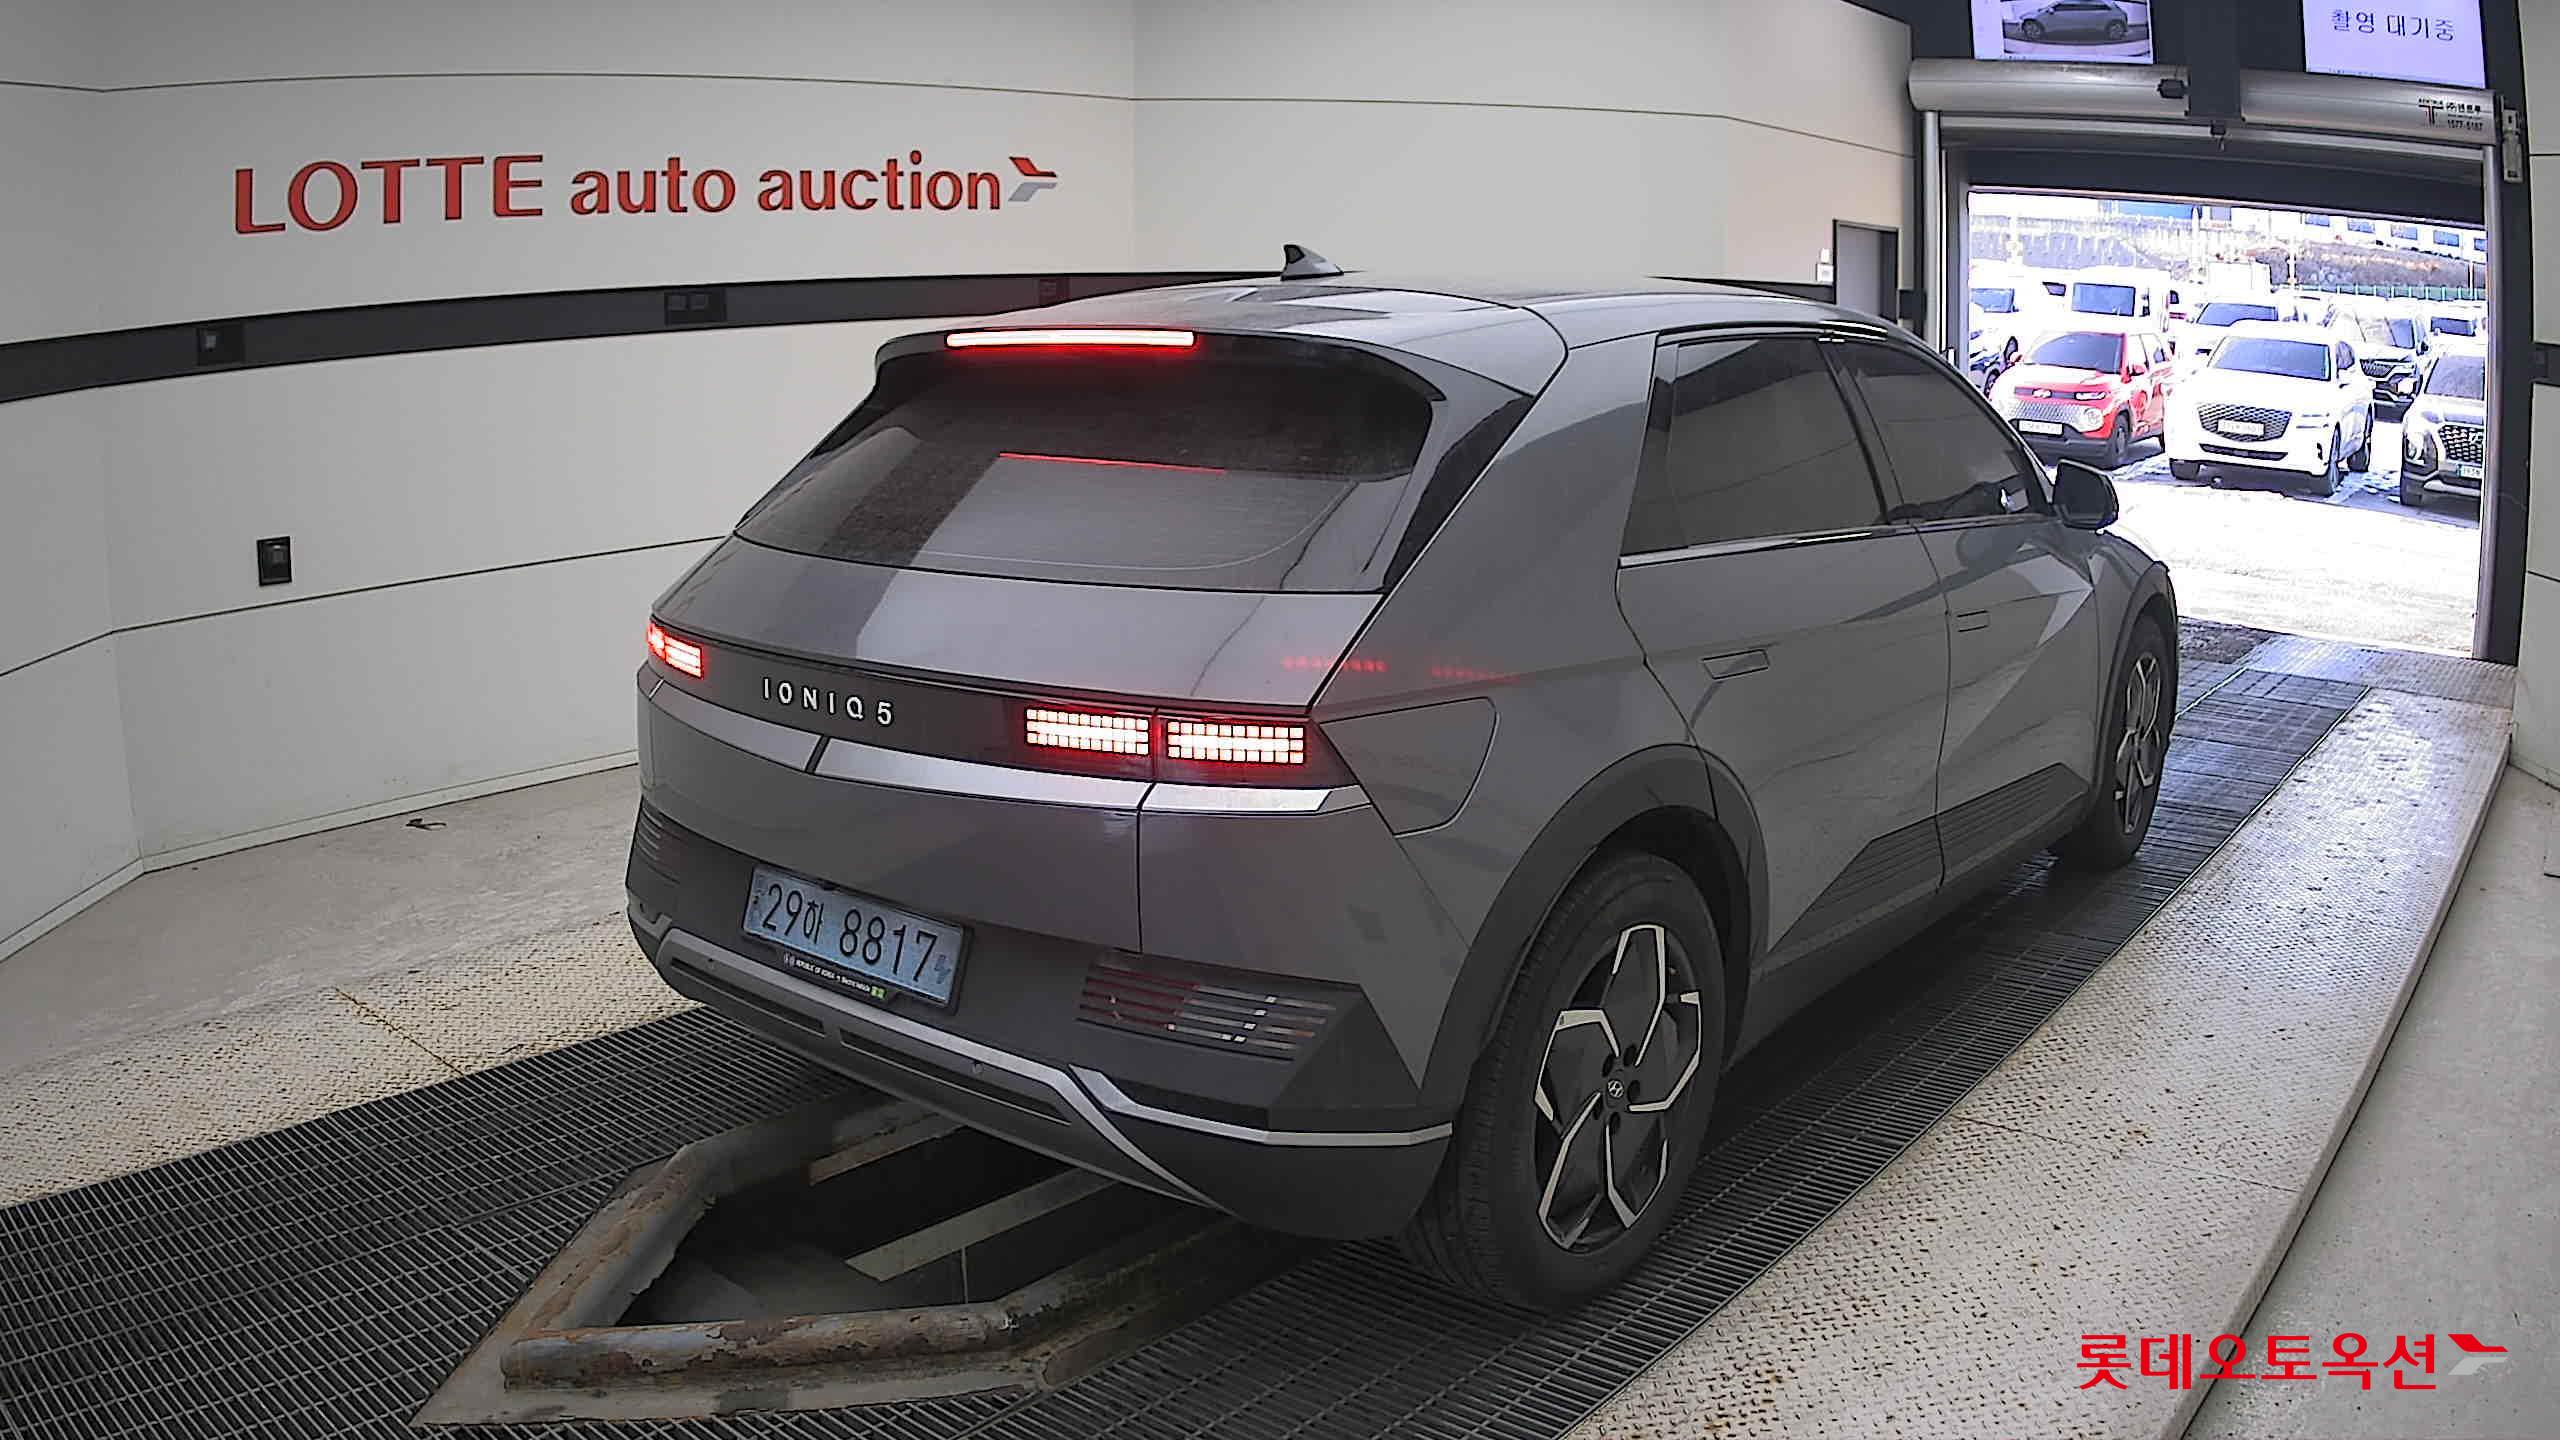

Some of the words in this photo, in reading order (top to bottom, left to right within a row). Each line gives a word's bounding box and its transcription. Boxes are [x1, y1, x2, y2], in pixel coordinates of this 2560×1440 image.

[2331, 9, 2376, 34] 촬영
[2387, 15, 2455, 42] 대기중
[234, 154, 545, 234] LOTTE
[569, 156, 738, 215] auto
[757, 150, 1002, 211] auction
[762, 677, 865, 720] IONIQ
[876, 700, 894, 726] 5
[762, 883, 824, 944] 29하
[839, 908, 938, 983] 8817
